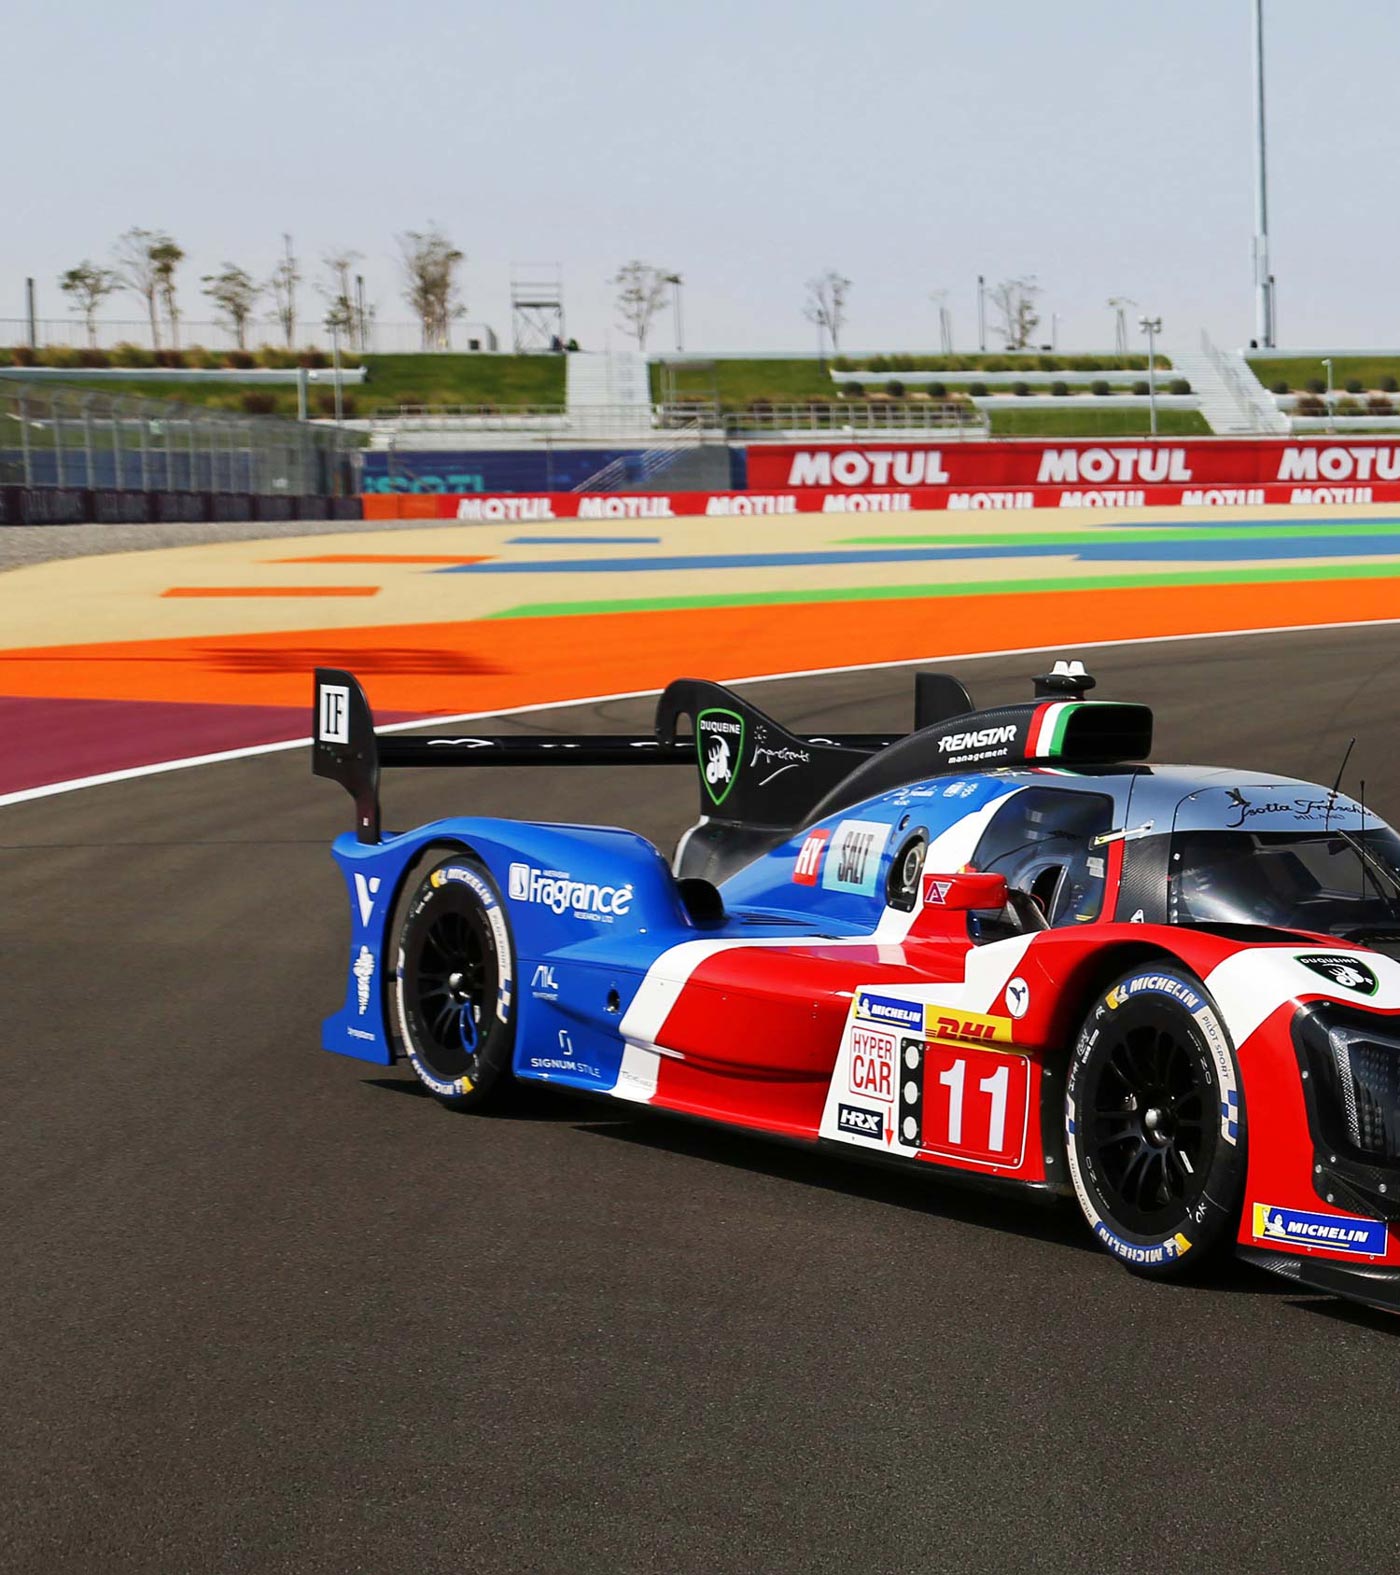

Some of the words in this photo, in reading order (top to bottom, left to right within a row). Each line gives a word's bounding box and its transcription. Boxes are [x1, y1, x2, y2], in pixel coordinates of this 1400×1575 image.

[789, 452, 948, 486] MOTUL
[1038, 449, 1192, 483] MOTUL
[700, 720, 741, 734] DUQUEINE
[938, 724, 1017, 752] REMSTAR
[948, 748, 1008, 764] management
[529, 868, 634, 915] Fragrance
[1130, 976, 1199, 1009] MICHELIN
[871, 1003, 922, 1023] MICHELIN
[936, 1016, 997, 1041] DHL
[853, 1032, 893, 1060] HYPER
[530, 1058, 576, 1070] SIGNUM
[852, 1055, 892, 1096] CAR
[939, 1059, 1009, 1152] 11
[839, 1109, 881, 1132] HRX
[1099, 1227, 1163, 1263] MICHELIN
[1287, 1221, 1369, 1243] MICHELIN
